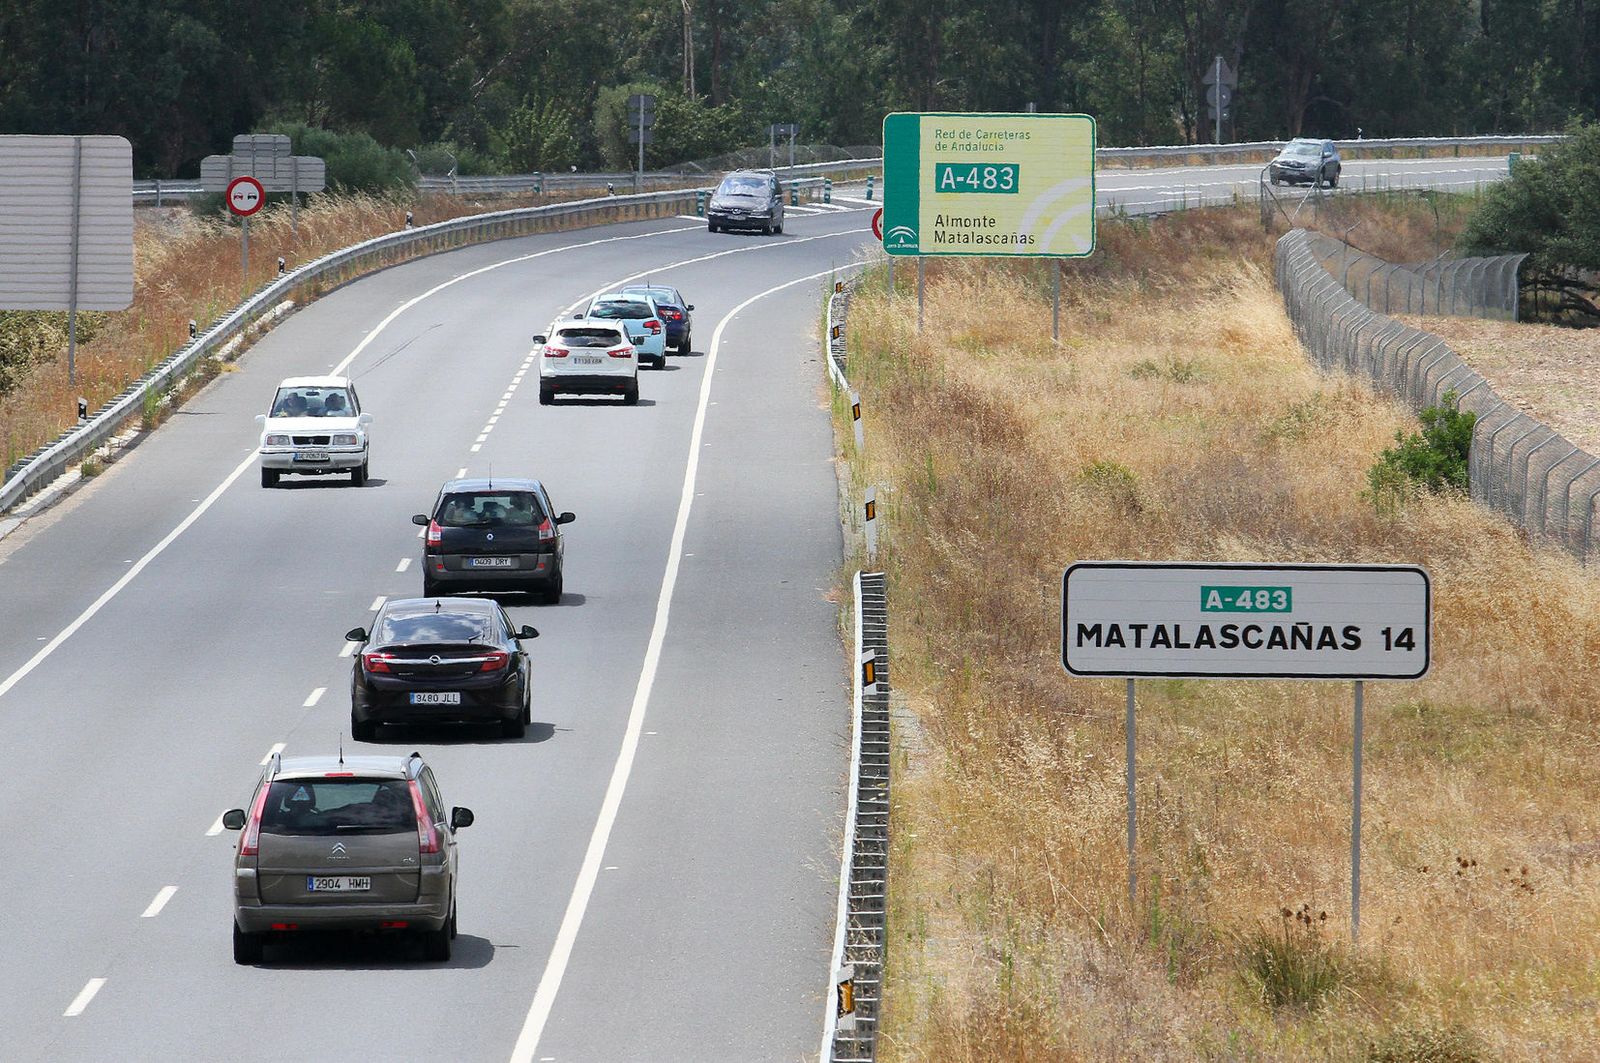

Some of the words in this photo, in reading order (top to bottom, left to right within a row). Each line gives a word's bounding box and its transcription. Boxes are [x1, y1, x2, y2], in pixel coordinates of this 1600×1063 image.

[935, 129, 955, 139] Red
[958, 129, 972, 139] de
[976, 129, 1031, 140] Carreteras
[935, 141, 948, 151] de
[941, 167, 1014, 190] A-483
[935, 214, 996, 228] Almonte
[934, 231, 1035, 245] Matalascañas
[1205, 589, 1289, 610] A-483
[1076, 622, 1362, 651] MATALASCAÑAS
[1382, 627, 1416, 652] 14
[416, 693, 439, 703] 9480
[442, 693, 458, 703] JLL
[315, 878, 341, 889] 2904
[348, 878, 369, 889] HMH
